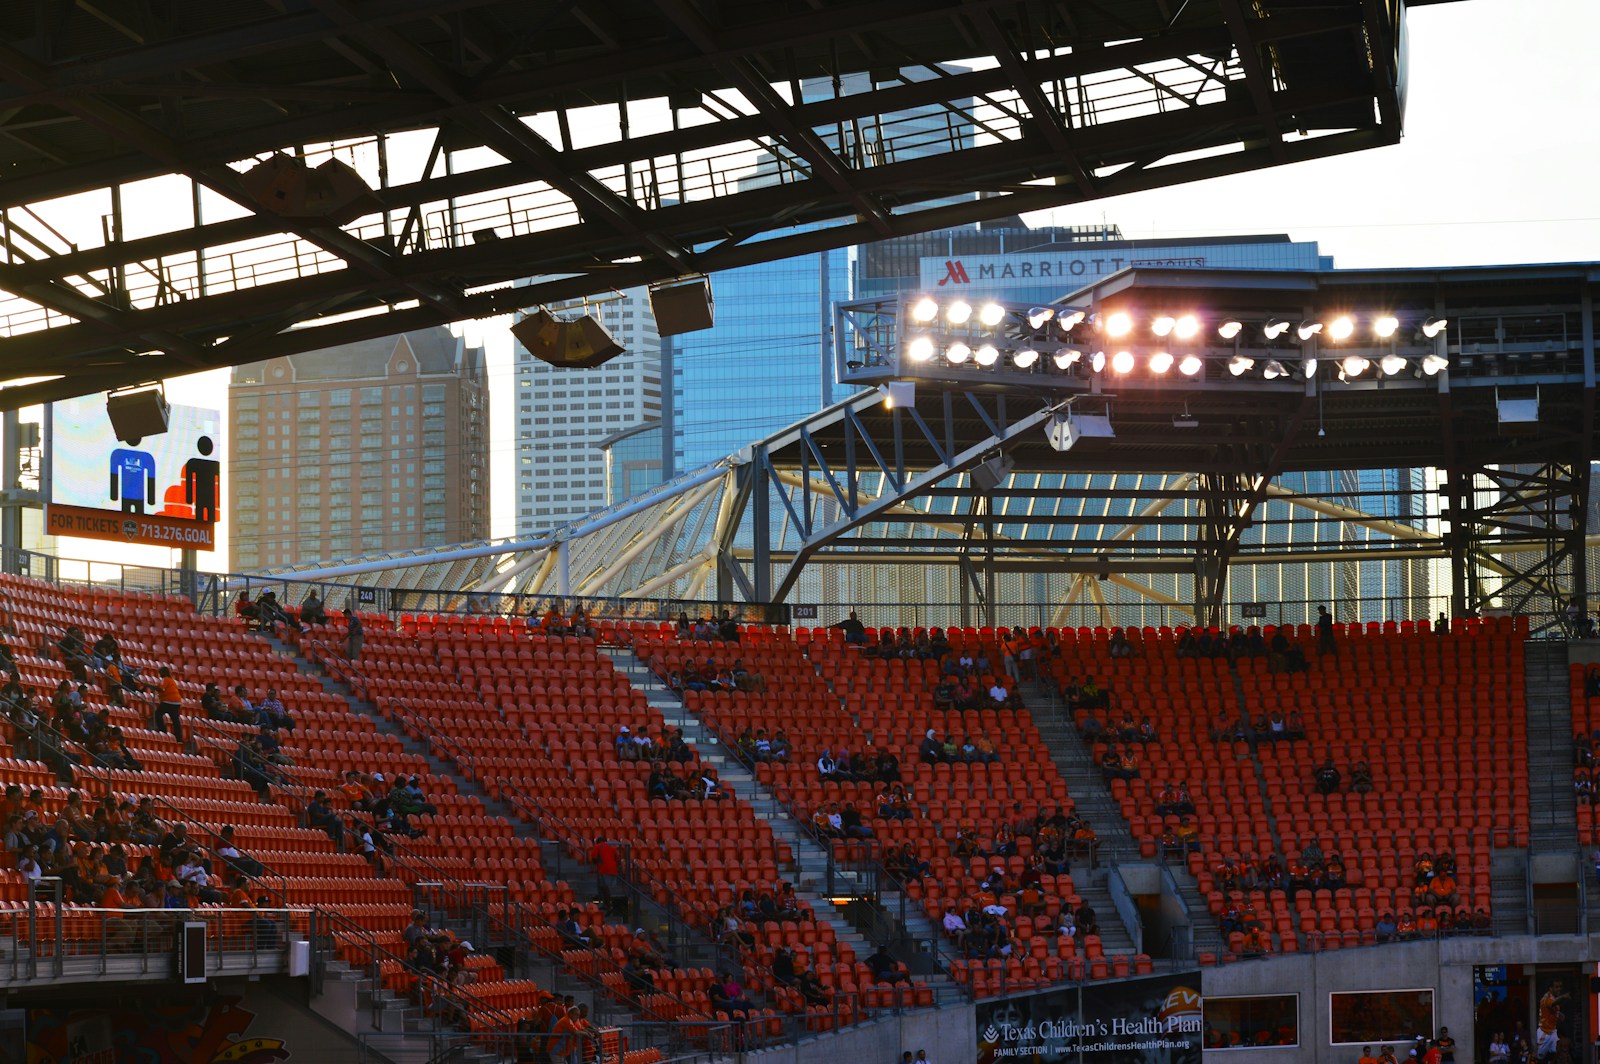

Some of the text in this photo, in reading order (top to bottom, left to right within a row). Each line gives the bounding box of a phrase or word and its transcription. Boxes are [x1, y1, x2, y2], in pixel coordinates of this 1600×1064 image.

[979, 258, 1125, 279] MARRIOTT
[51, 513, 73, 529] FOR
[76, 515, 119, 534] TICKETS
[141, 523, 212, 544] 713.276.GOAL
[360, 591, 373, 601] 240
[659, 600, 684, 614] Plan
[797, 607, 814, 616] 201
[1245, 606, 1263, 615] 202
[1000, 1015, 1202, 1042] Texas Children's Health Plan
[993, 1040, 1190, 1058] FAMILY SECTION www.TexasChildrensHealthPlan.org
